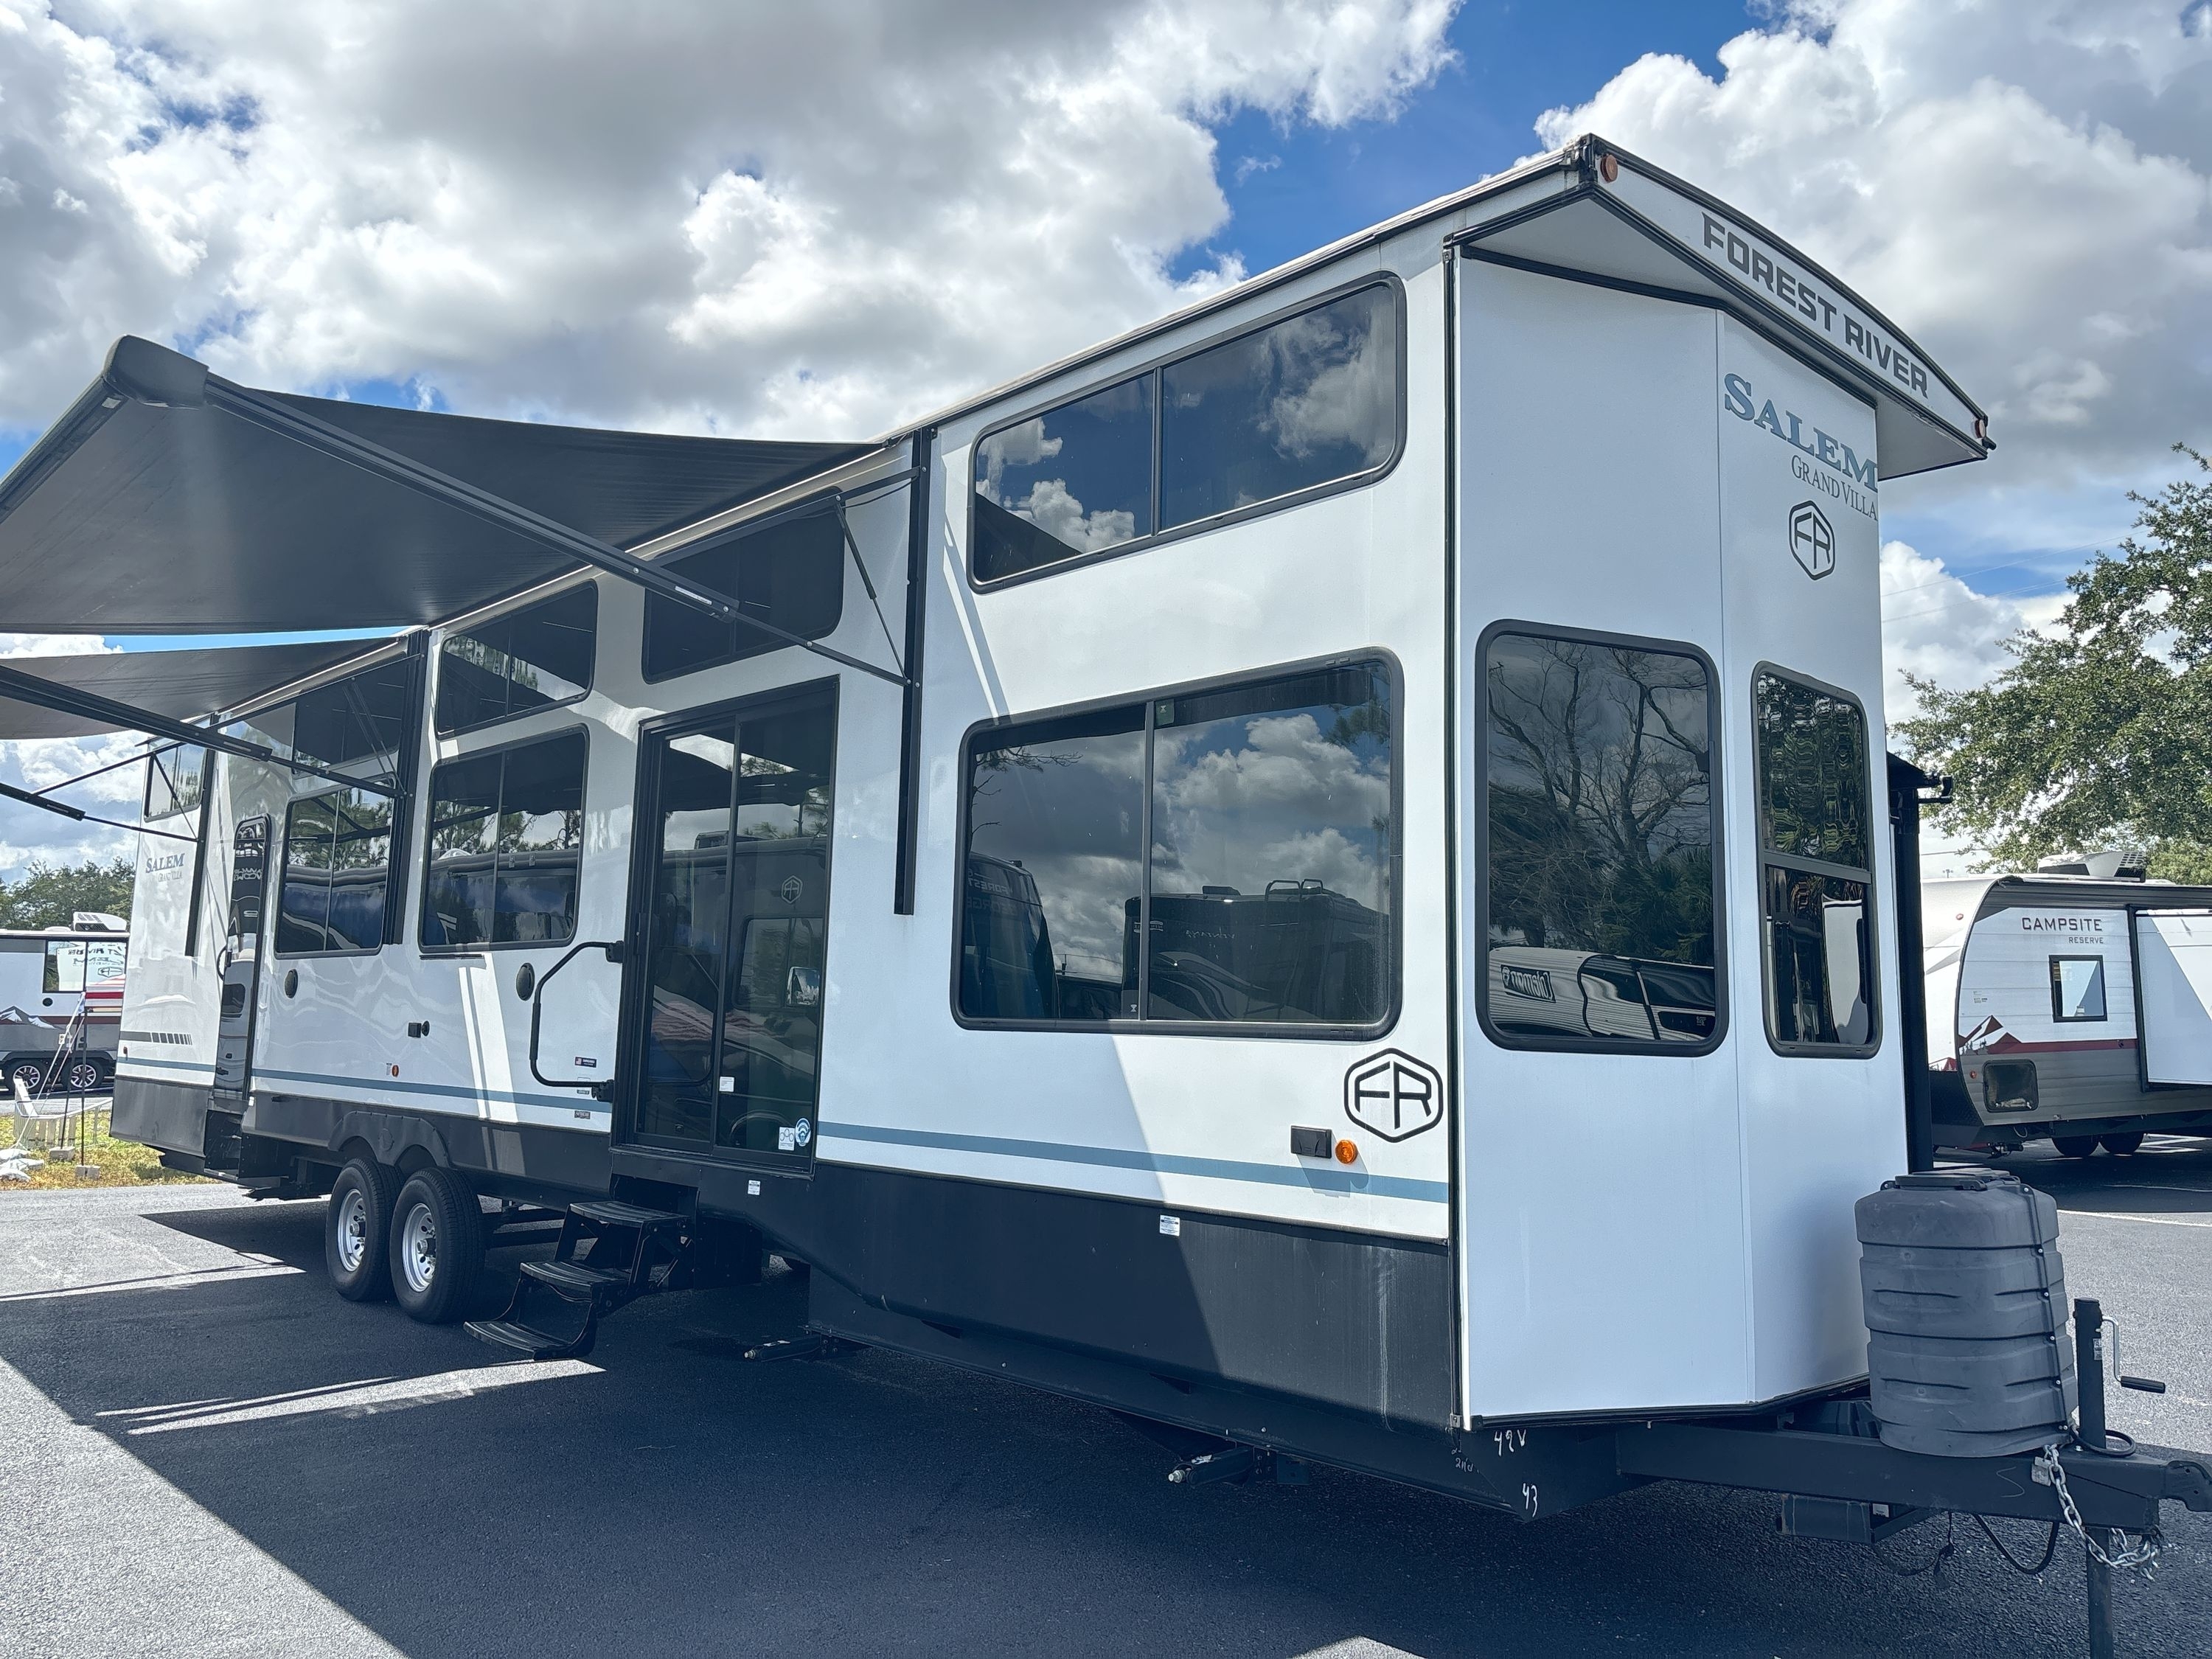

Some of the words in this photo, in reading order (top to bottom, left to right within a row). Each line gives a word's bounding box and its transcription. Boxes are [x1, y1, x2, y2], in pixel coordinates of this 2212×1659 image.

[1701, 212, 1837, 332] FOREST
[1843, 313, 1929, 399] RIVER
[1724, 372, 1878, 493] SALEM
[1792, 454, 1840, 498] GRAND
[1840, 480, 1878, 522] VILLA
[145, 852, 185, 874] SALEM
[2022, 917, 2103, 931] CAMPSITE
[2068, 936, 2104, 945] RESERVE
[1353, 1059, 1433, 1132] FR
[1522, 1483, 1538, 1518] 43
